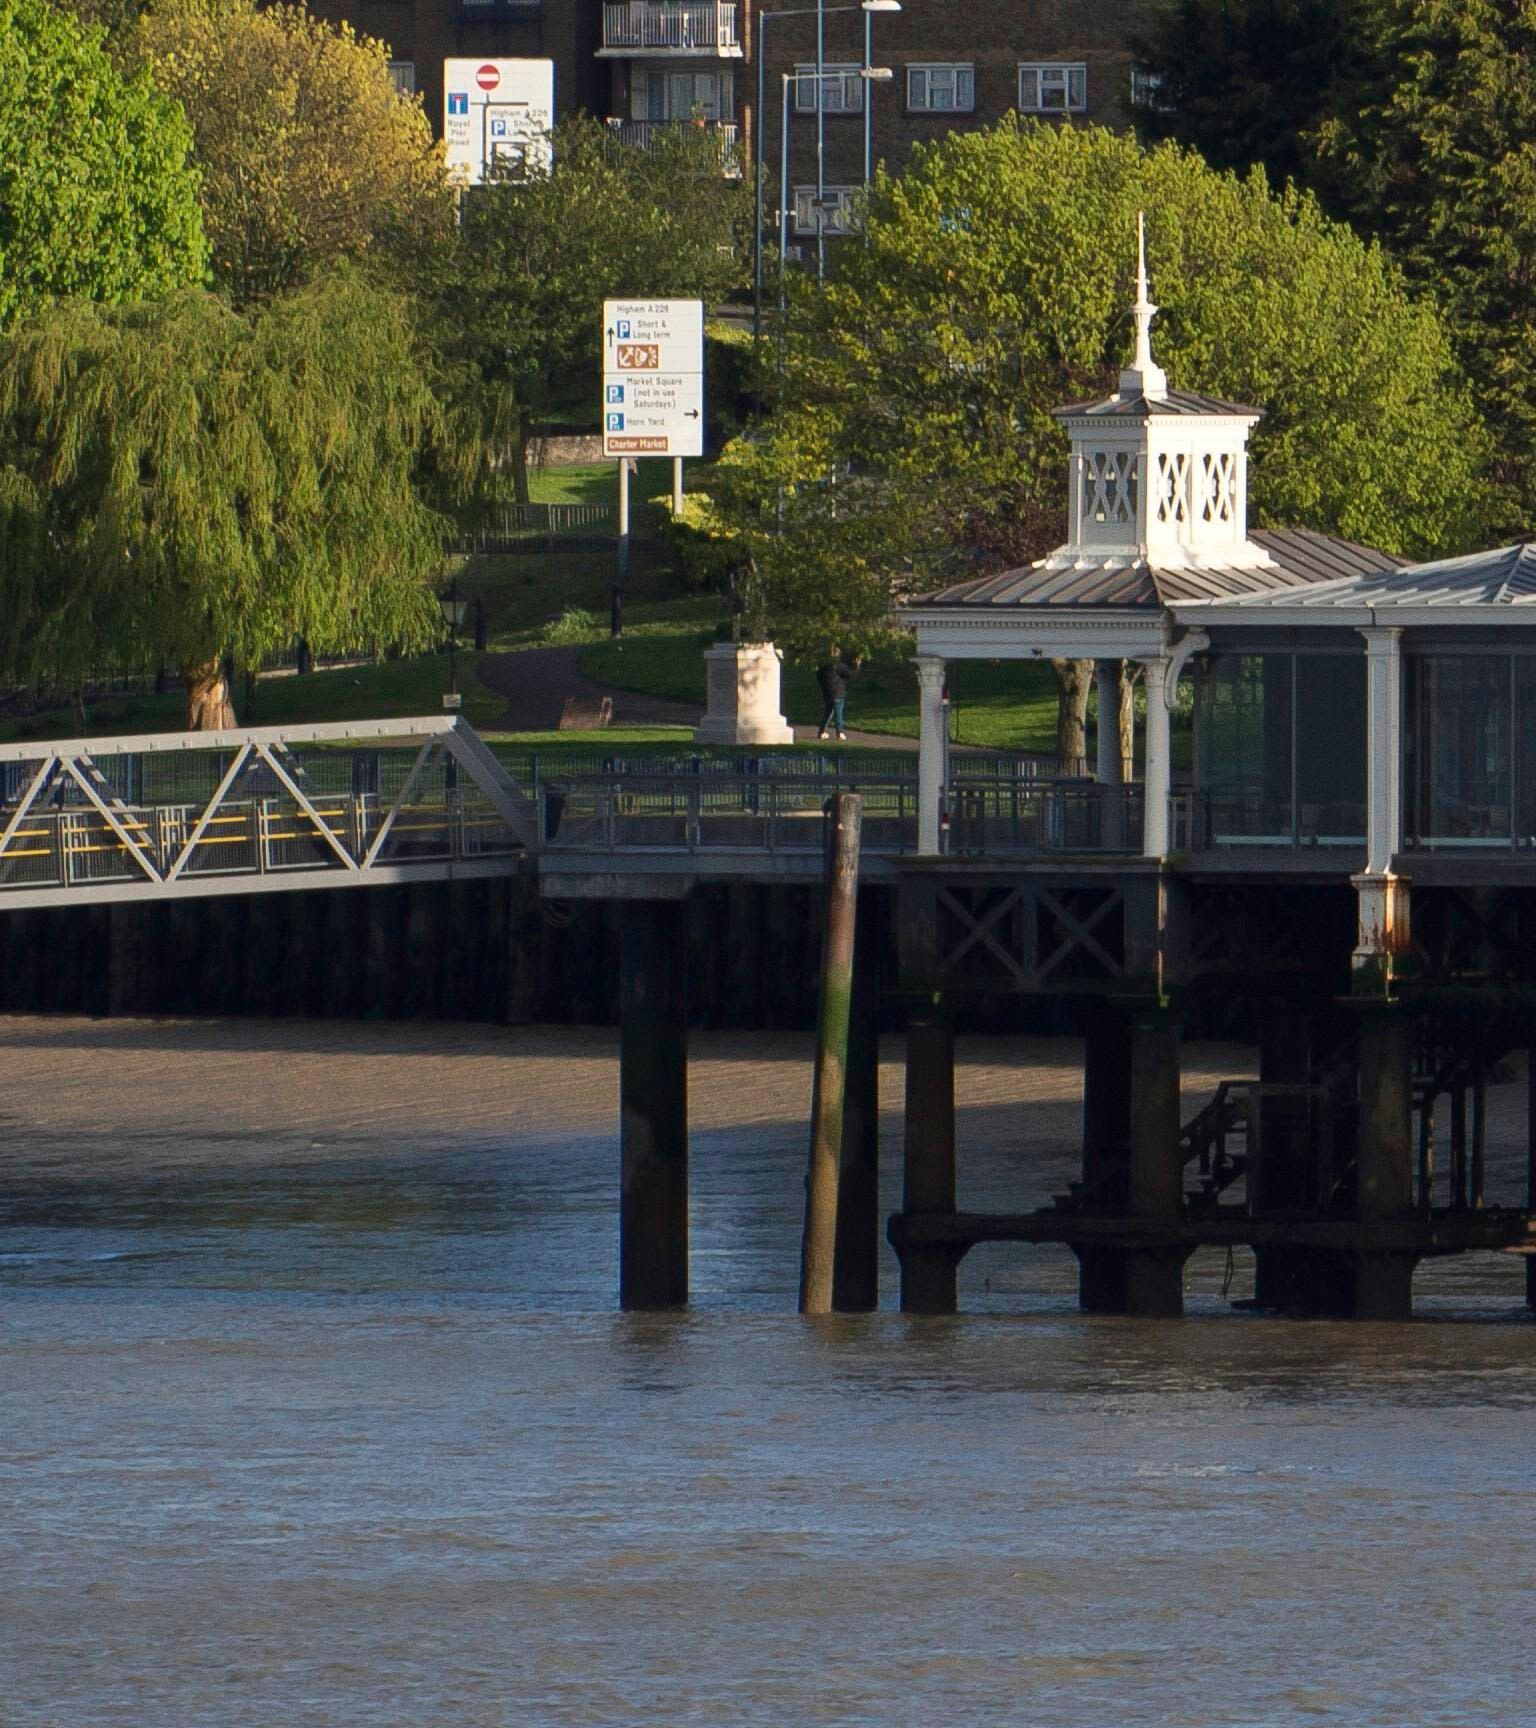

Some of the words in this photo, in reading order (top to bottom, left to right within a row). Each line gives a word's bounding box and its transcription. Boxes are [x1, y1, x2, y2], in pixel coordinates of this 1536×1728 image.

[448, 119, 471, 128] Royal
[450, 129, 466, 137] Pier
[448, 138, 470, 146] Road
[617, 304, 646, 315] Higham
[637, 320, 659, 329] Short
[633, 330, 651, 340] Long
[653, 330, 671, 339] term
[626, 377, 653, 385] Market
[656, 377, 683, 387] Square
[633, 388, 650, 397] (not
[633, 400, 677, 410] Saturdays)
[647, 417, 665, 426] Yard
[609, 438, 637, 449] Charter
[639, 438, 666, 449] Market
